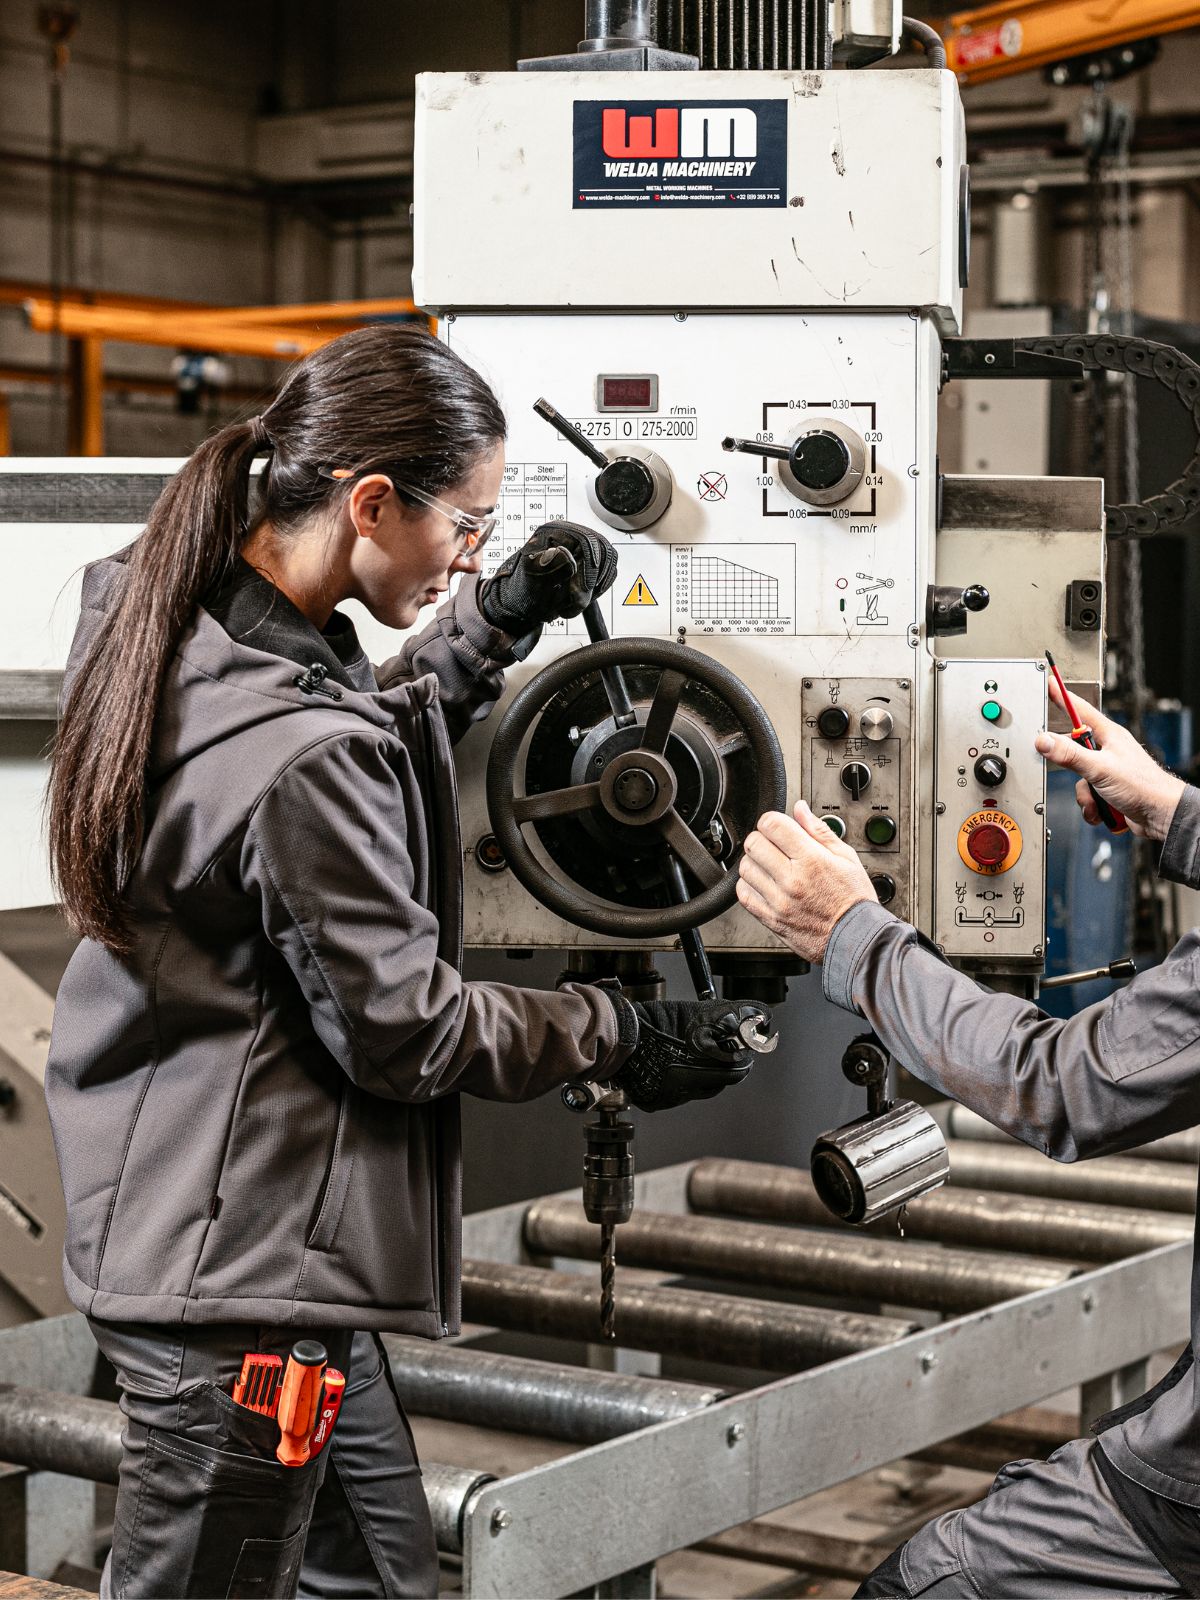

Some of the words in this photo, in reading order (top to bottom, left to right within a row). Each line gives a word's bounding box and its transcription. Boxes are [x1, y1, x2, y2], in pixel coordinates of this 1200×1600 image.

[603, 162, 658, 178] WELDA
[662, 161, 756, 178] MACHINERY
[670, 405, 696, 415] r/min
[788, 400, 807, 410] 0.43
[831, 400, 850, 410] 0.30
[569, 421, 611, 436] 8-275
[623, 421, 632, 437] 0
[642, 421, 694, 436] 275-2000
[755, 432, 774, 443] 0.68
[864, 432, 883, 442] 0.20
[537, 465, 555, 474] Steel
[756, 476, 774, 486] 1.00
[865, 476, 883, 486] 0.14
[789, 508, 807, 518] 0.06
[832, 508, 850, 518] 0.09
[849, 523, 877, 534] mm/r
[962, 812, 1017, 835] EMERGENCY
[977, 862, 1003, 873] STOP
